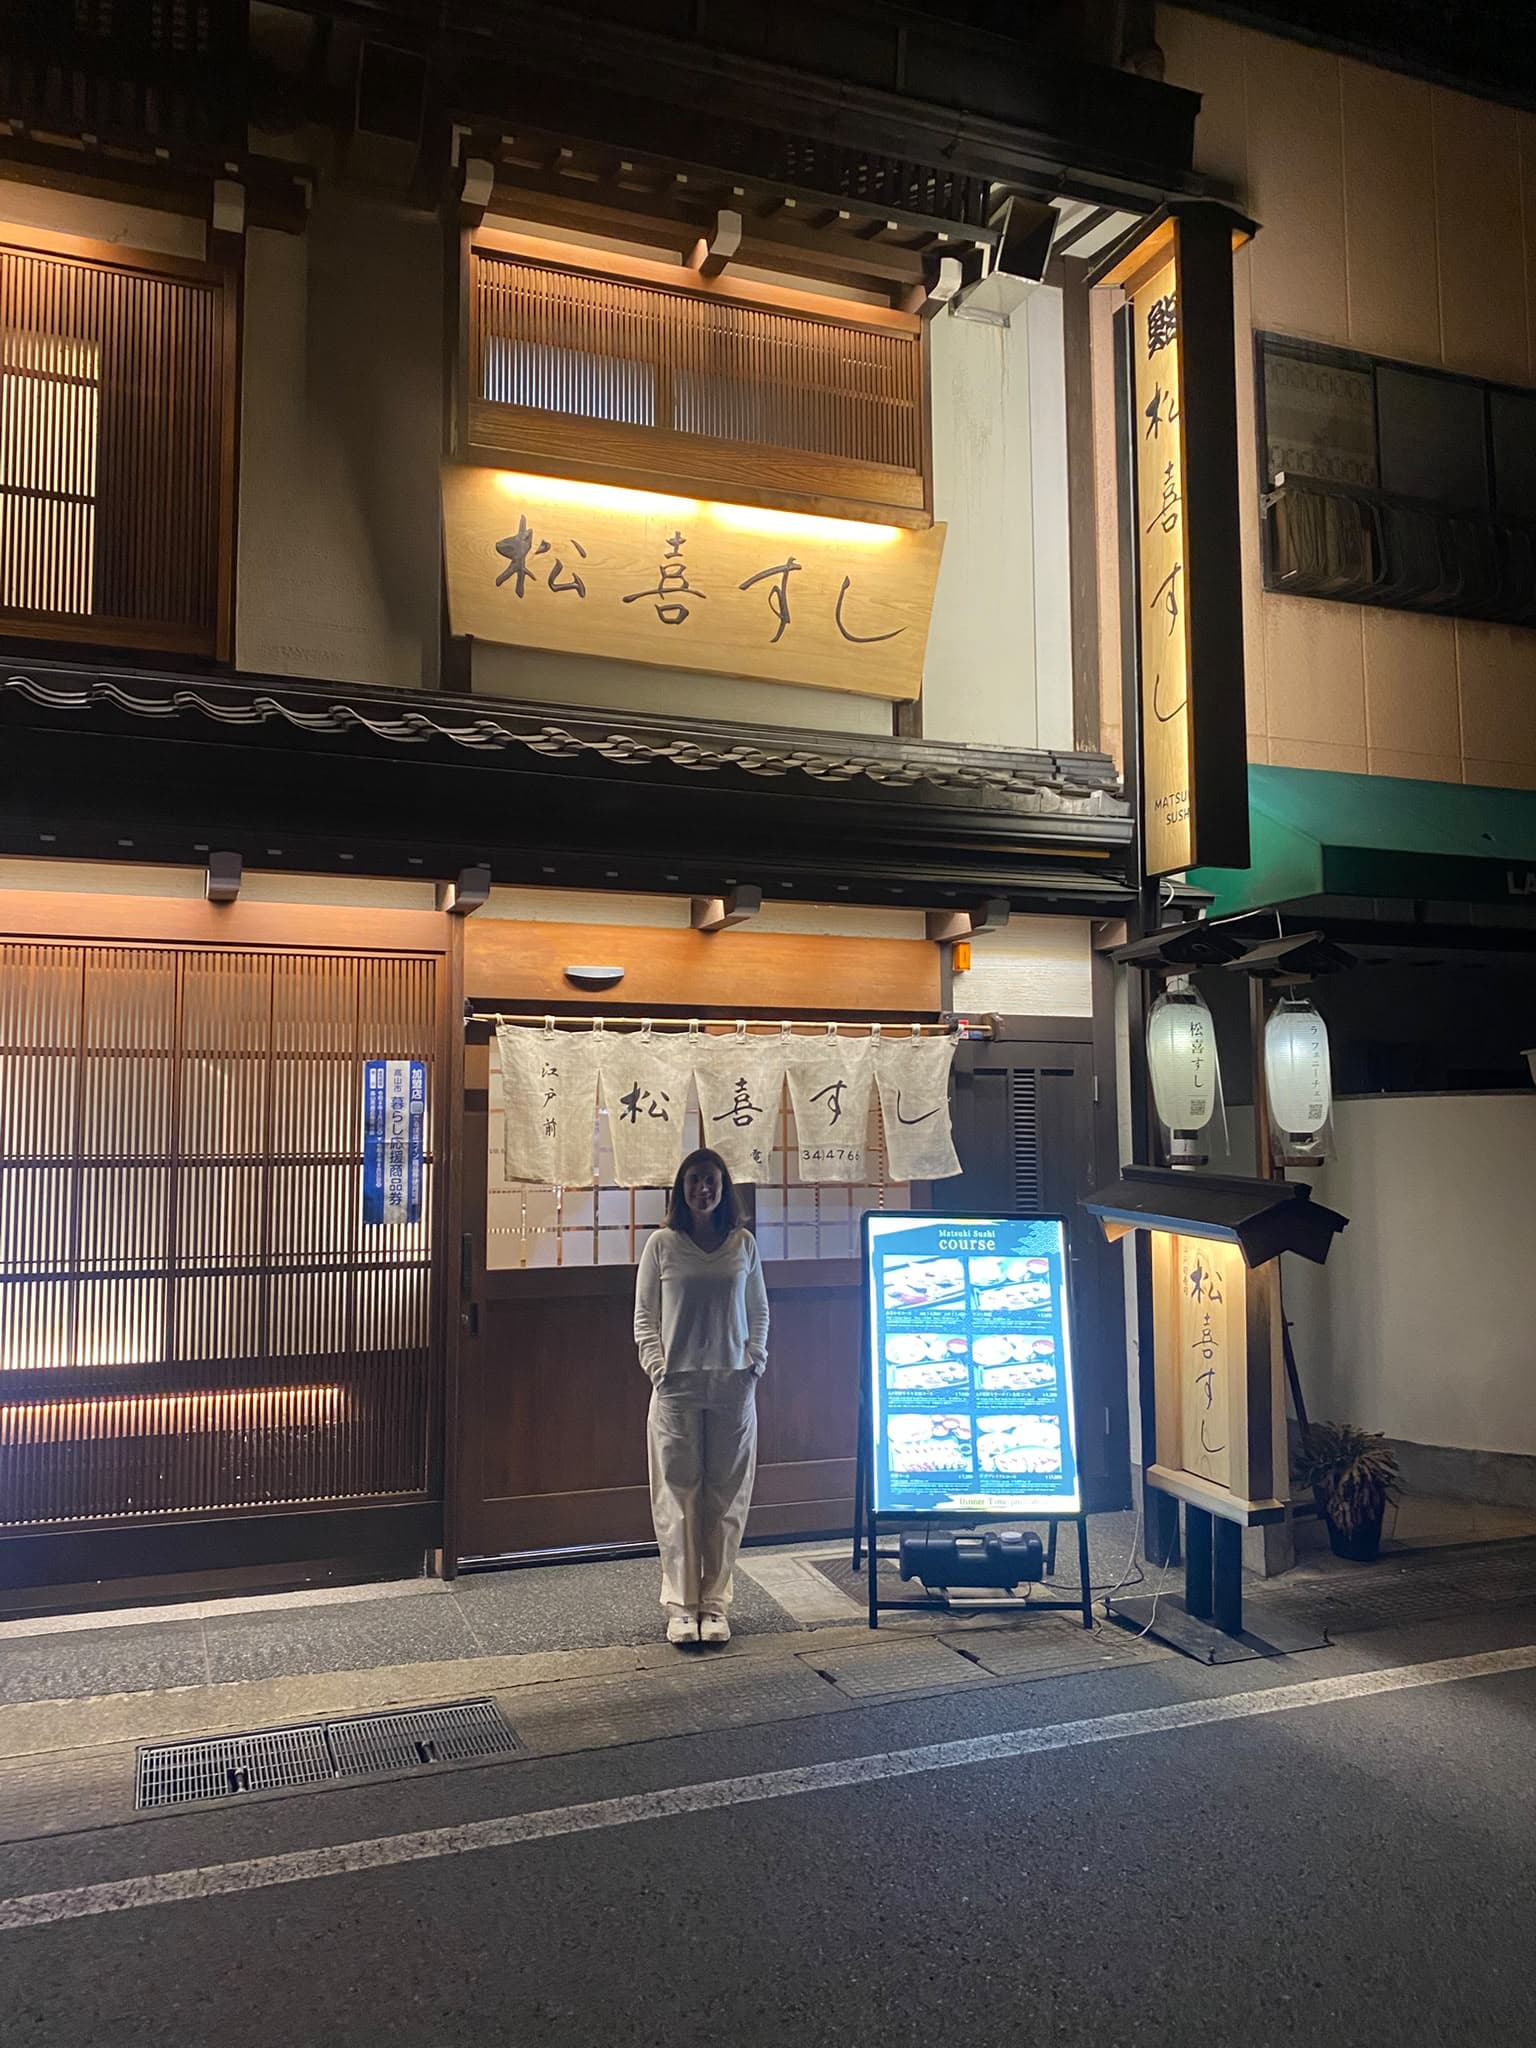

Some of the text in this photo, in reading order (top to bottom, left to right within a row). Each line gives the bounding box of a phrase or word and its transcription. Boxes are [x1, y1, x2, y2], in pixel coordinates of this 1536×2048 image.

[495, 513, 908, 644] 松喜すし
[541, 1061, 560, 1138] 江戸前
[619, 1076, 941, 1127] 松喜すし
[938, 1239, 996, 1251] course
[973, 1230, 996, 1239] Sushi
[1191, 1258, 1225, 1453] 松喜すし
